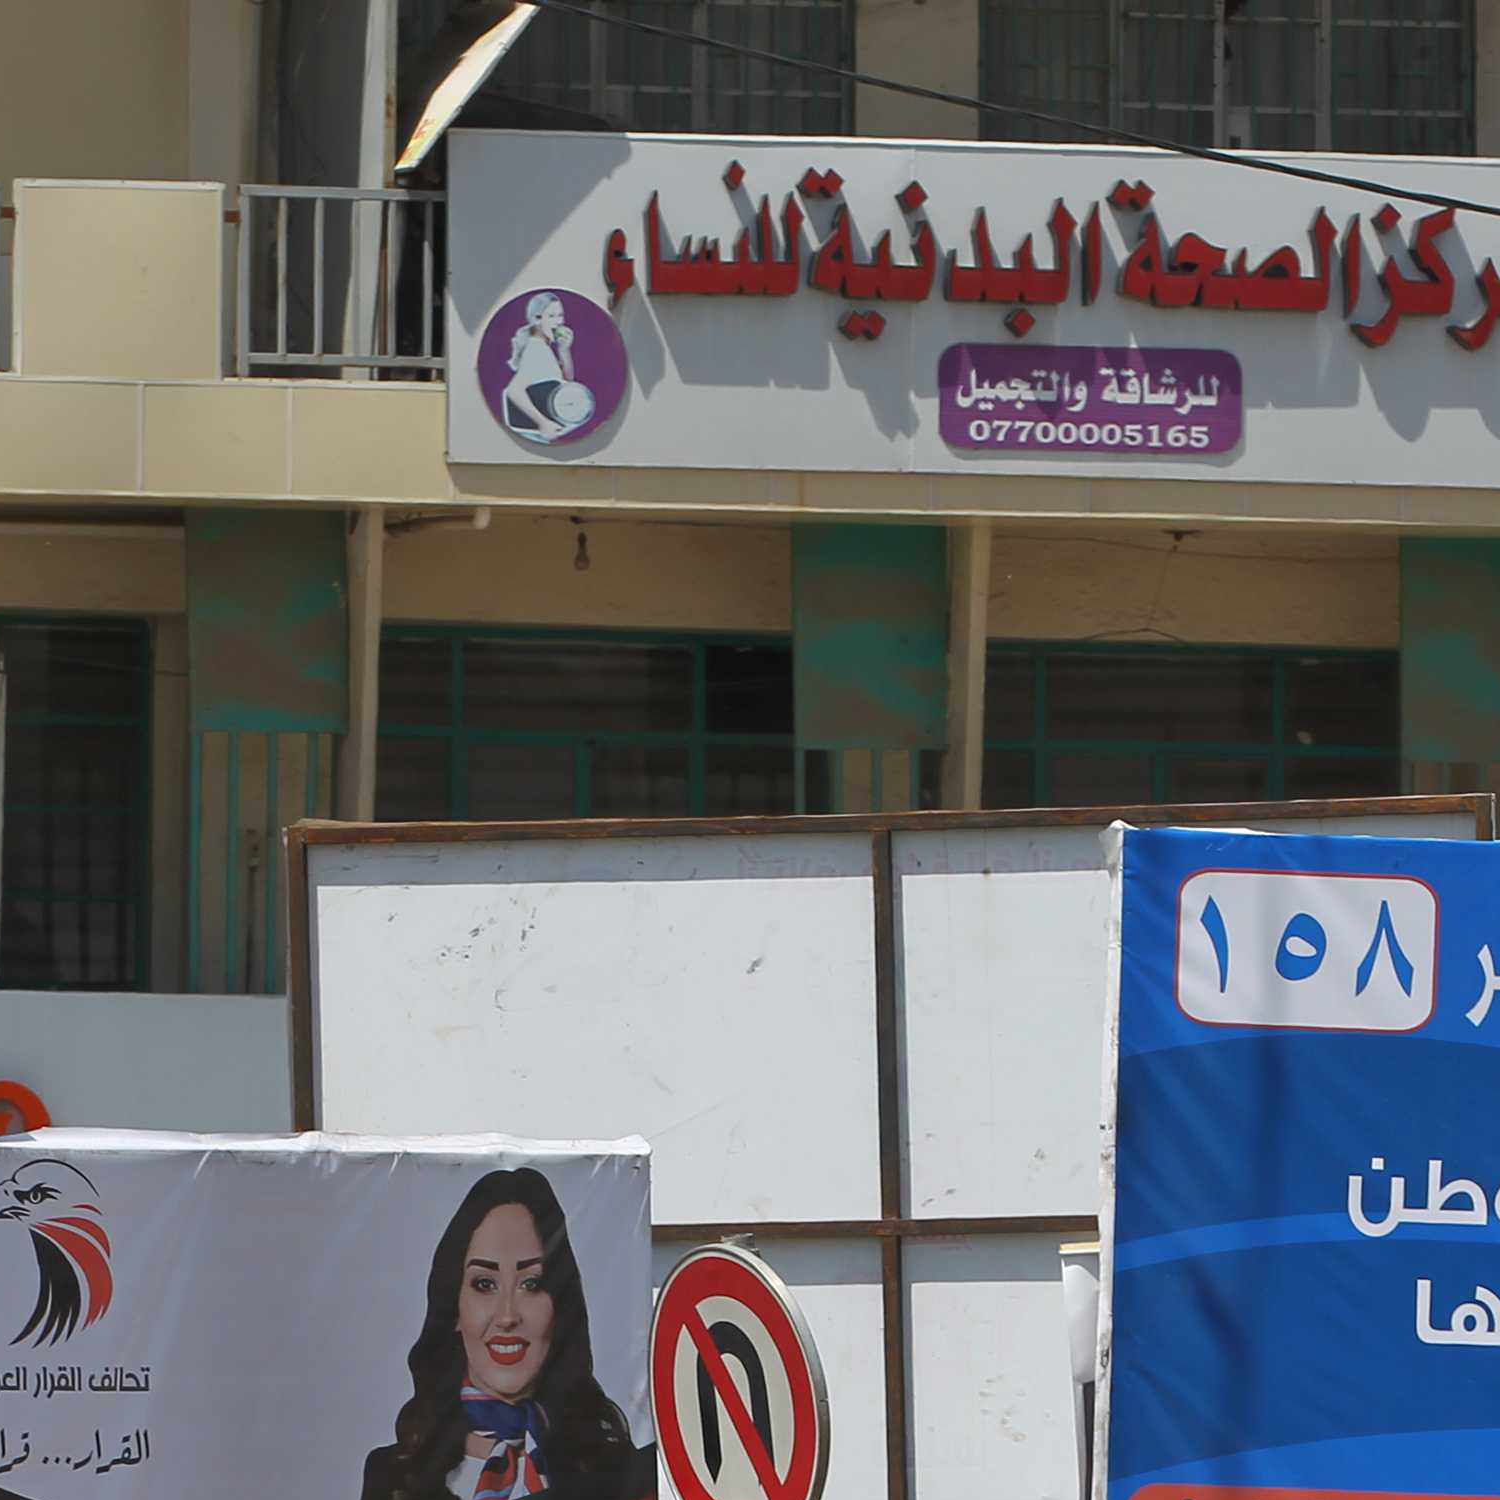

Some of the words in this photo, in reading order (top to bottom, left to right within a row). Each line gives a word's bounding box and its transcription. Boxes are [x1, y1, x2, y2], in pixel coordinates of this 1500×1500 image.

[603, 160, 804, 308] للنساء
[797, 167, 1100, 340] البدنية
[1109, 179, 1361, 320] الصحة
[955, 367, 1088, 412] والتجميل
[1098, 367, 1220, 415] للرشاقة
[968, 418, 1210, 448] 07700005165
[1196, 892, 1416, 1001] ١٥٨
[32, 1365, 82, 1399] القرار
[88, 1366, 150, 1392] تحالف
